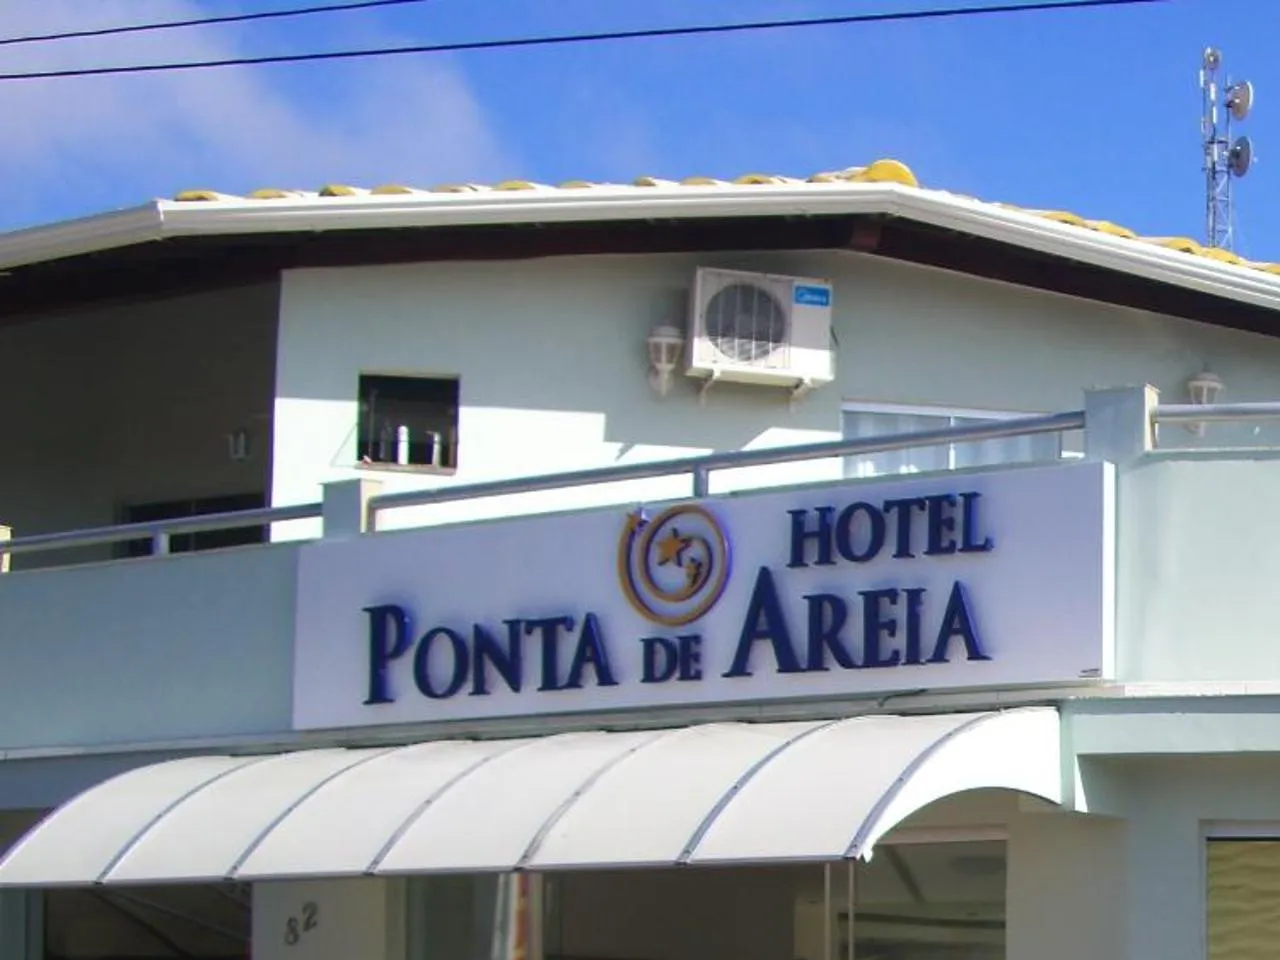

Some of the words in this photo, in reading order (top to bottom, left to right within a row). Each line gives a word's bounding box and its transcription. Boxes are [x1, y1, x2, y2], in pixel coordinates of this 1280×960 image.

[787, 492, 993, 568] HOTEL
[362, 605, 618, 705] PONTA
[639, 634, 703, 684] DE
[722, 566, 993, 679] AREIA
[284, 900, 319, 946] 82
